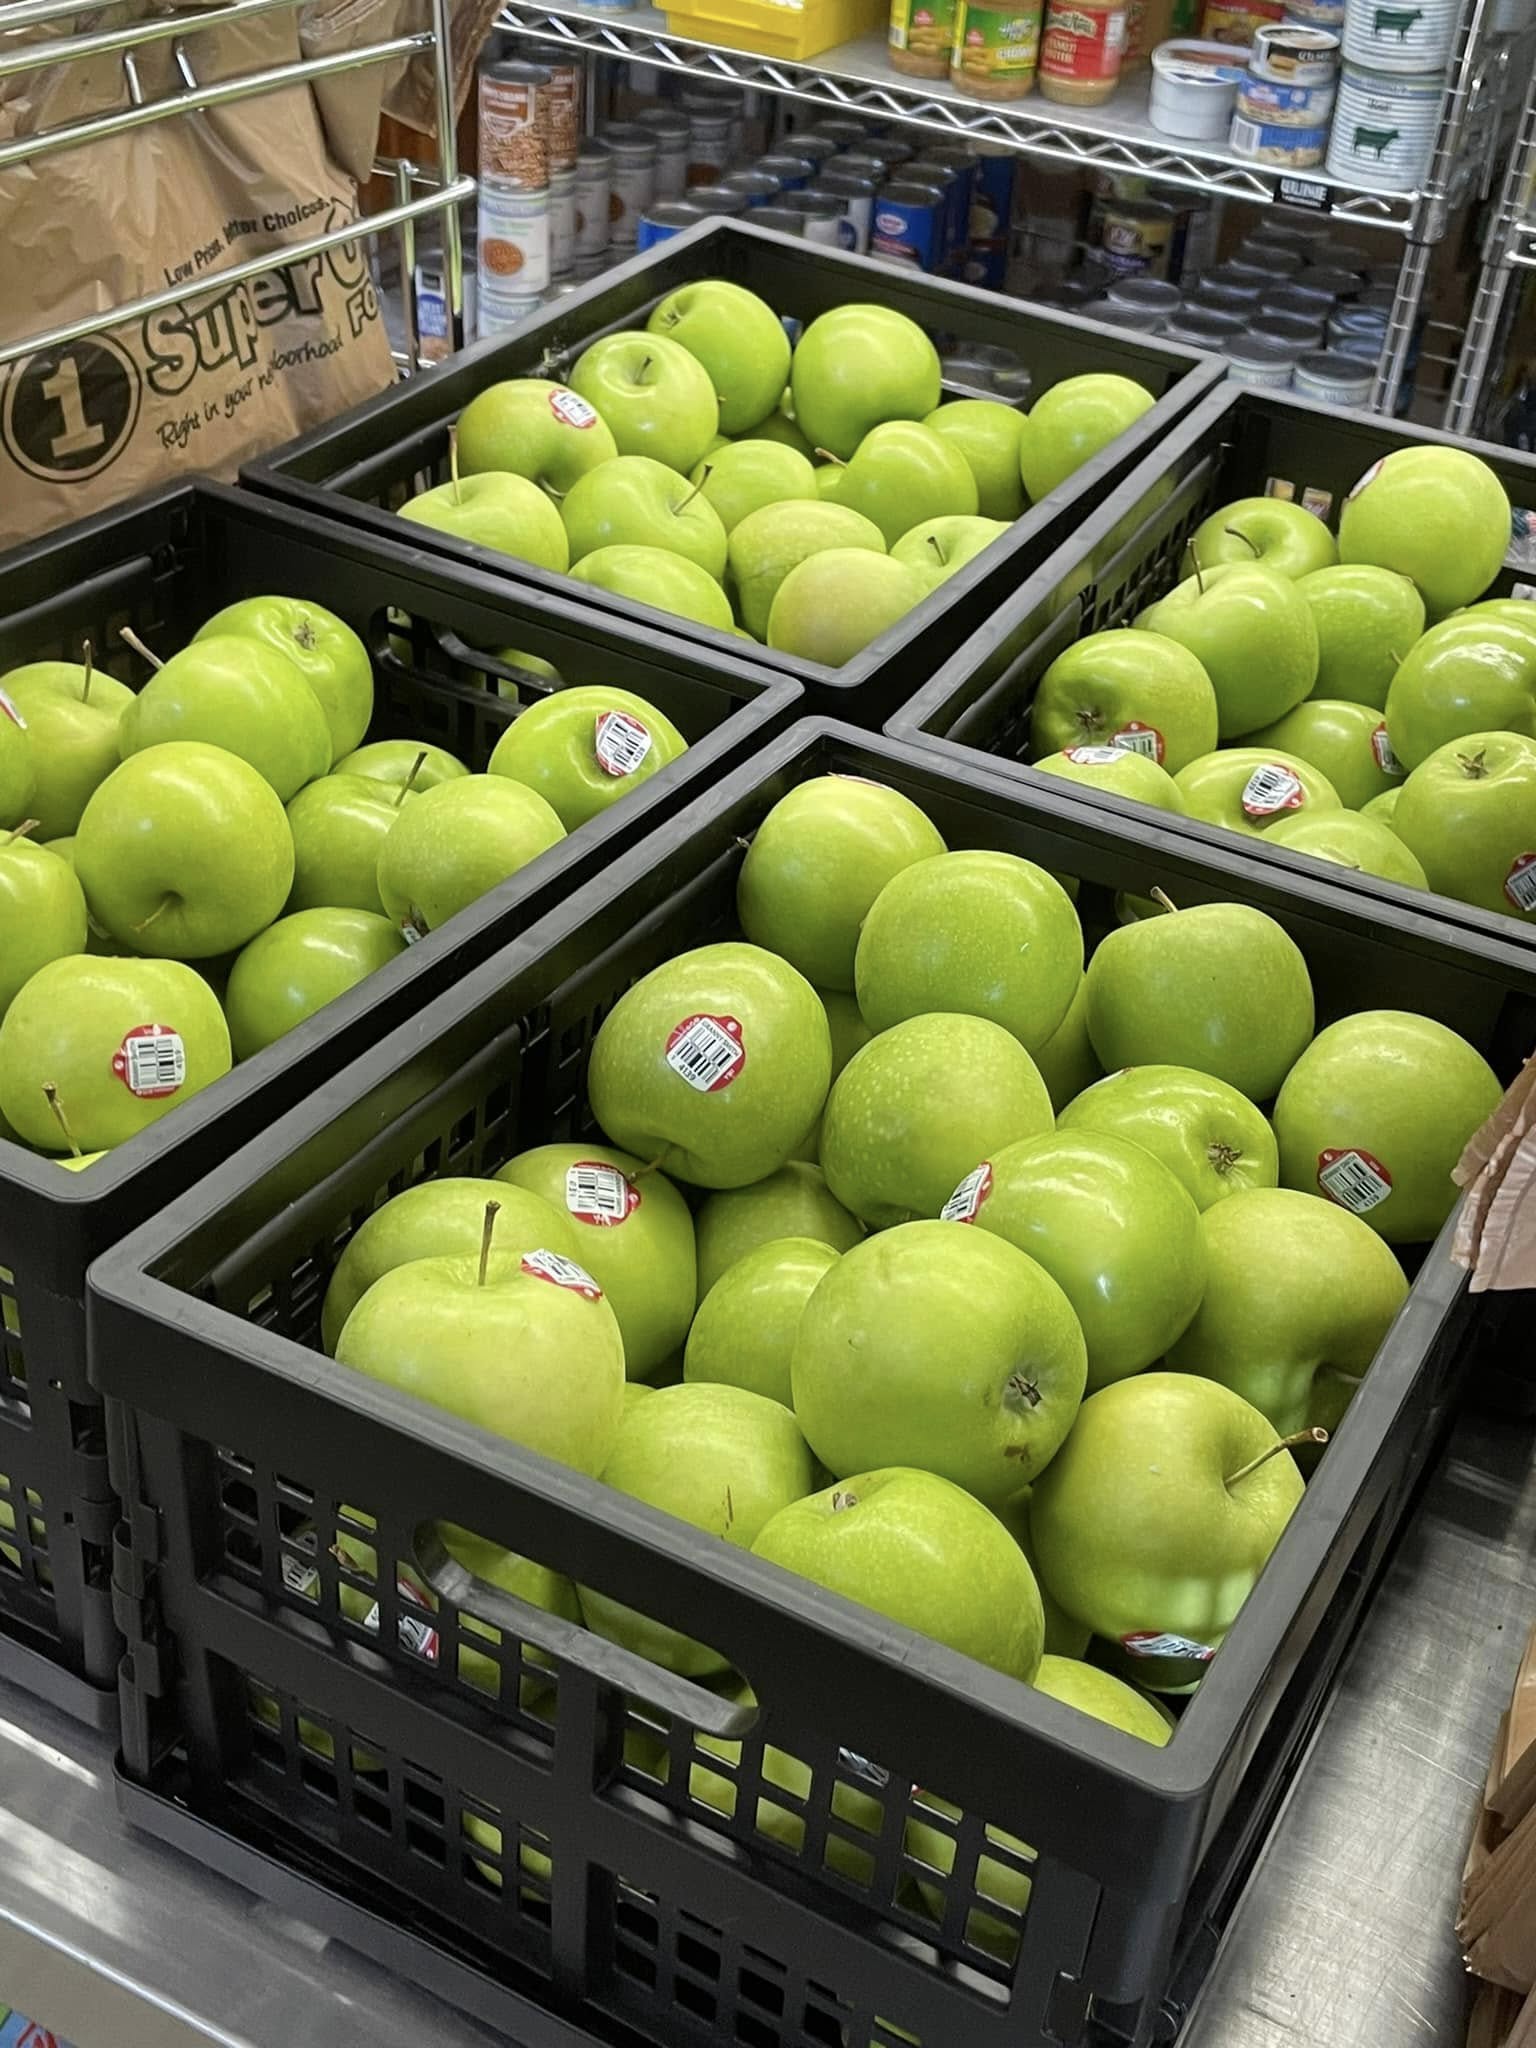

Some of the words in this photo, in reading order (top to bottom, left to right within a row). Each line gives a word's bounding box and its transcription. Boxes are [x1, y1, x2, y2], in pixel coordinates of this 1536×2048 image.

[163, 261, 193, 288] Low
[142, 252, 323, 396] Super
[41, 356, 105, 458] 1
[156, 410, 201, 448] Right
[204, 402, 219, 422] in
[679, 1063, 697, 1081] 4139
